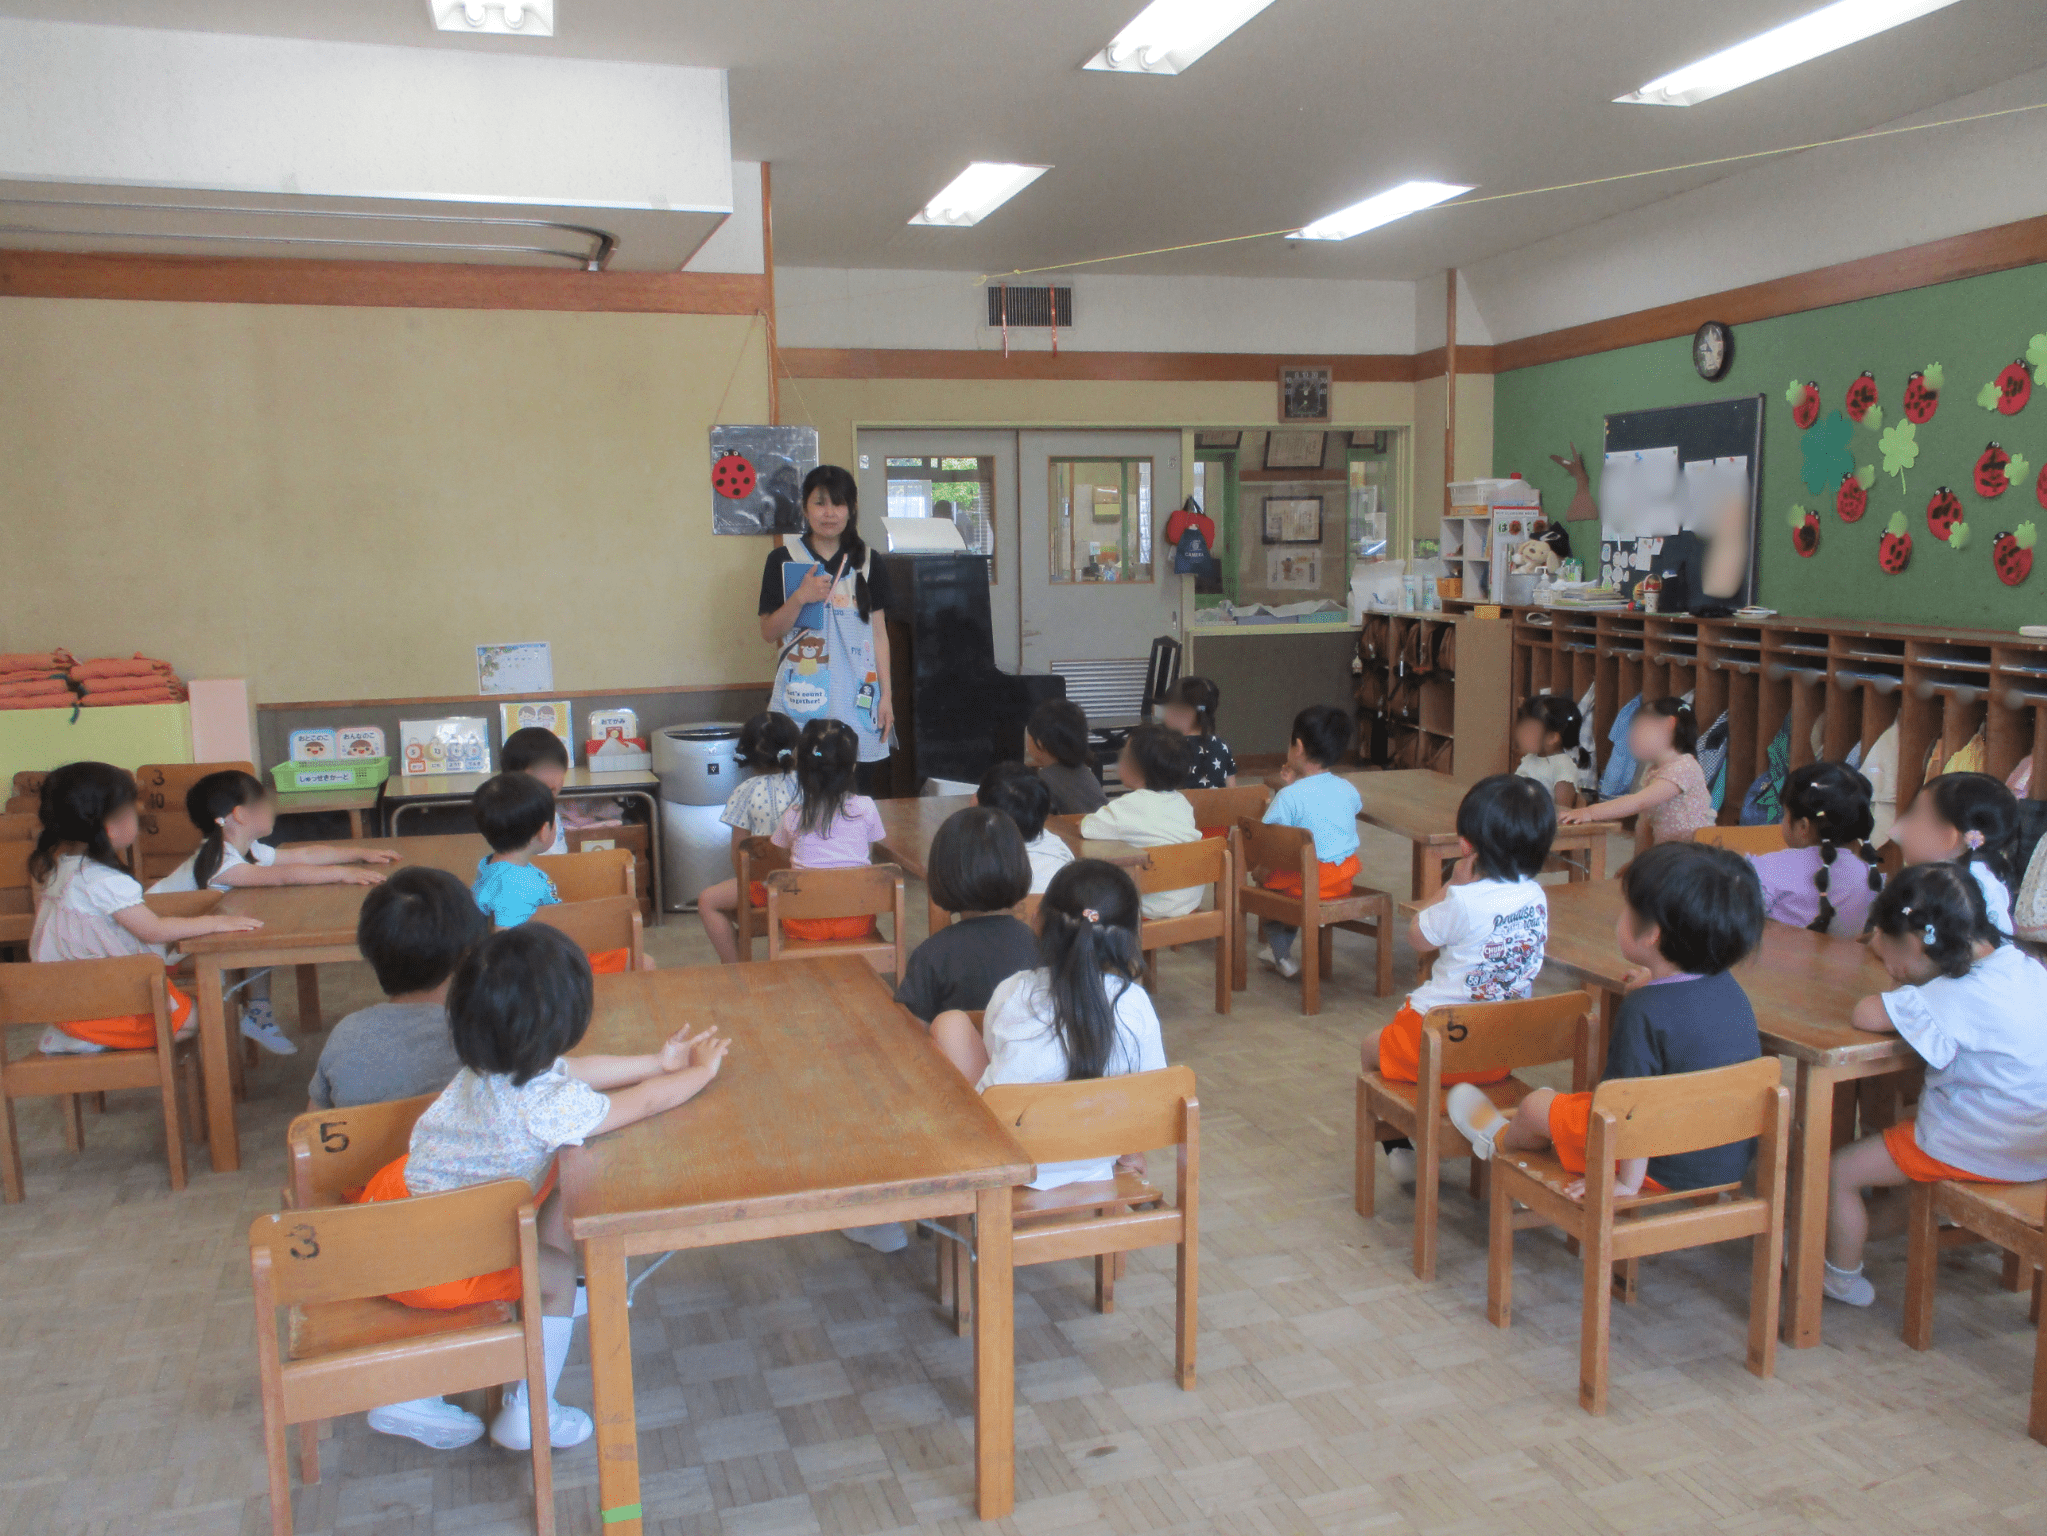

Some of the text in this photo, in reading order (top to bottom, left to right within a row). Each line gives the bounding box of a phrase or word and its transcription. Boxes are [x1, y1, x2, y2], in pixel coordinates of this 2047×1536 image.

[298, 734, 330, 742] おとこのこ
[343, 732, 376, 740] おんなのこ
[151, 768, 166, 786] 3
[299, 773, 350, 783] しゅっせきかーど
[319, 1120, 350, 1153] 5
[286, 1223, 321, 1260] 3
